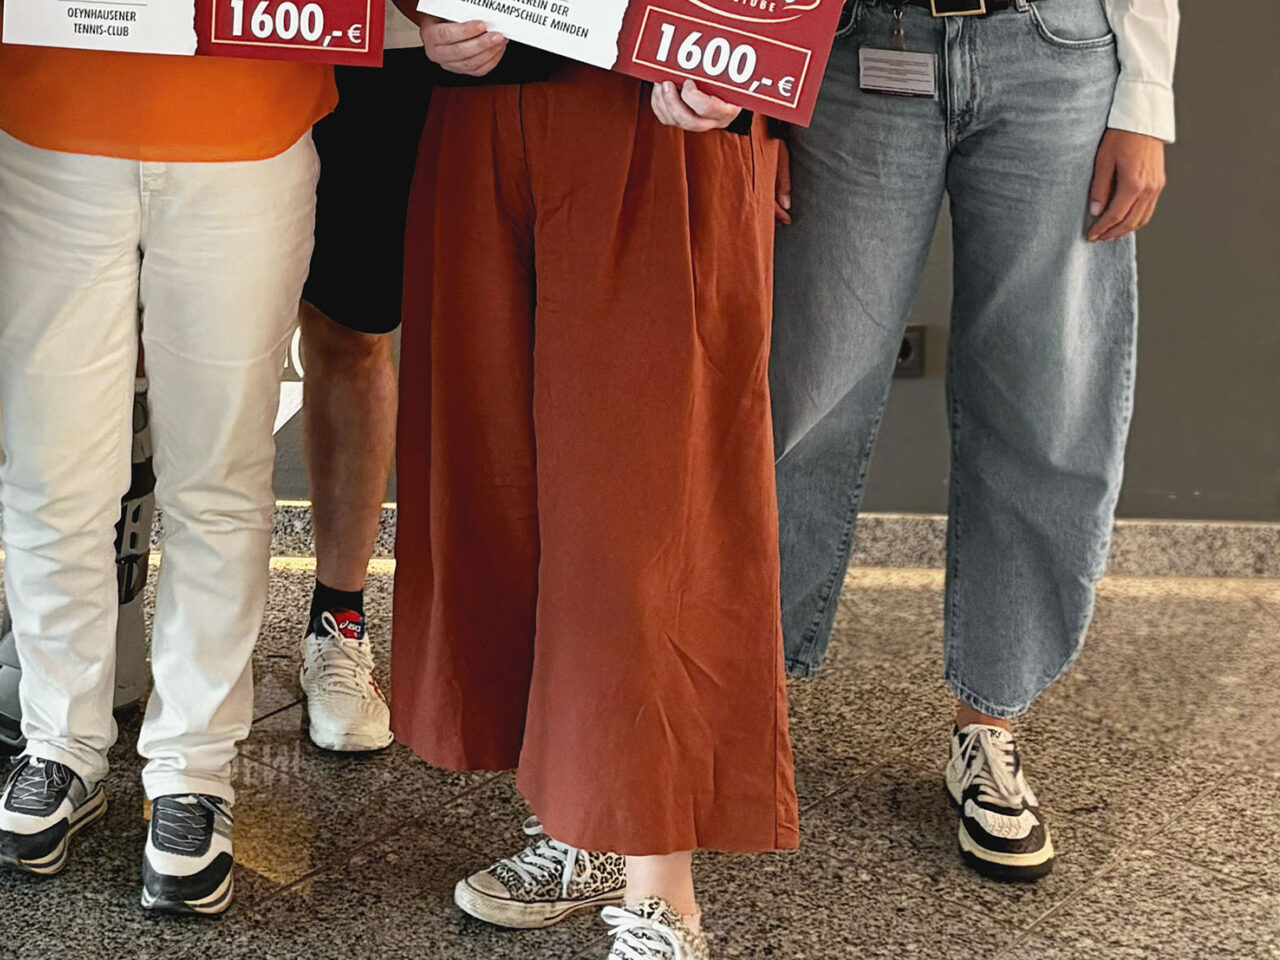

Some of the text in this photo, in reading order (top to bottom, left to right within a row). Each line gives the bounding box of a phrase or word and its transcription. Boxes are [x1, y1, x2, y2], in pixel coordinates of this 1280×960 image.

[67, 7, 137, 22] OEYNHAUSENER
[550, 1, 570, 18] DER
[73, 23, 130, 37] TENNIS-CLUB
[550, 17, 590, 39] MINDEN
